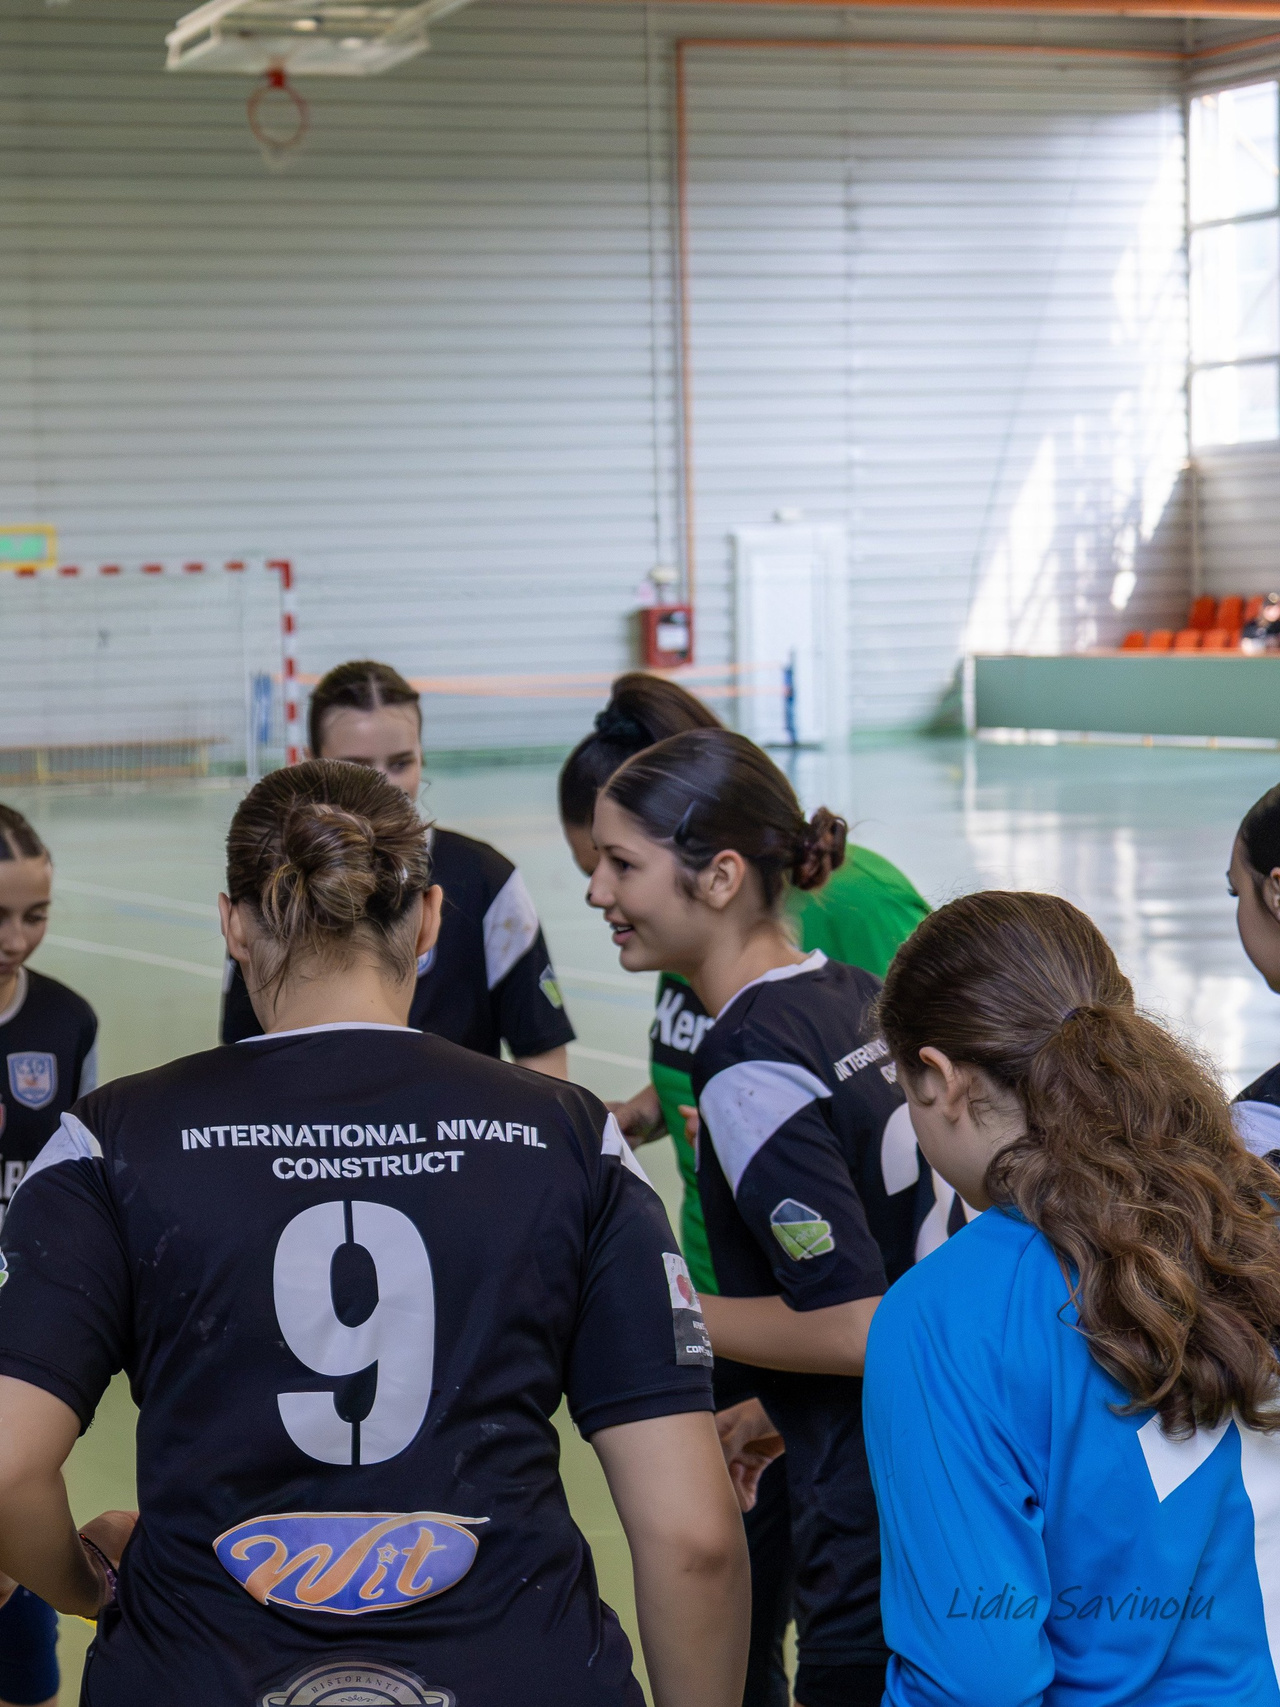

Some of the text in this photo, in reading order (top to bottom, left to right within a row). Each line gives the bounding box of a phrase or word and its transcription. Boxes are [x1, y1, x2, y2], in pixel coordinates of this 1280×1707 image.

[181, 1119, 547, 1150] INTERNATIONAL NIVAFIL
[272, 1150, 465, 1180] CONSTRUCT
[273, 1199, 435, 1467] 9
[230, 1511, 490, 1606] Wit
[311, 1675, 400, 1695] RISTORANTE
